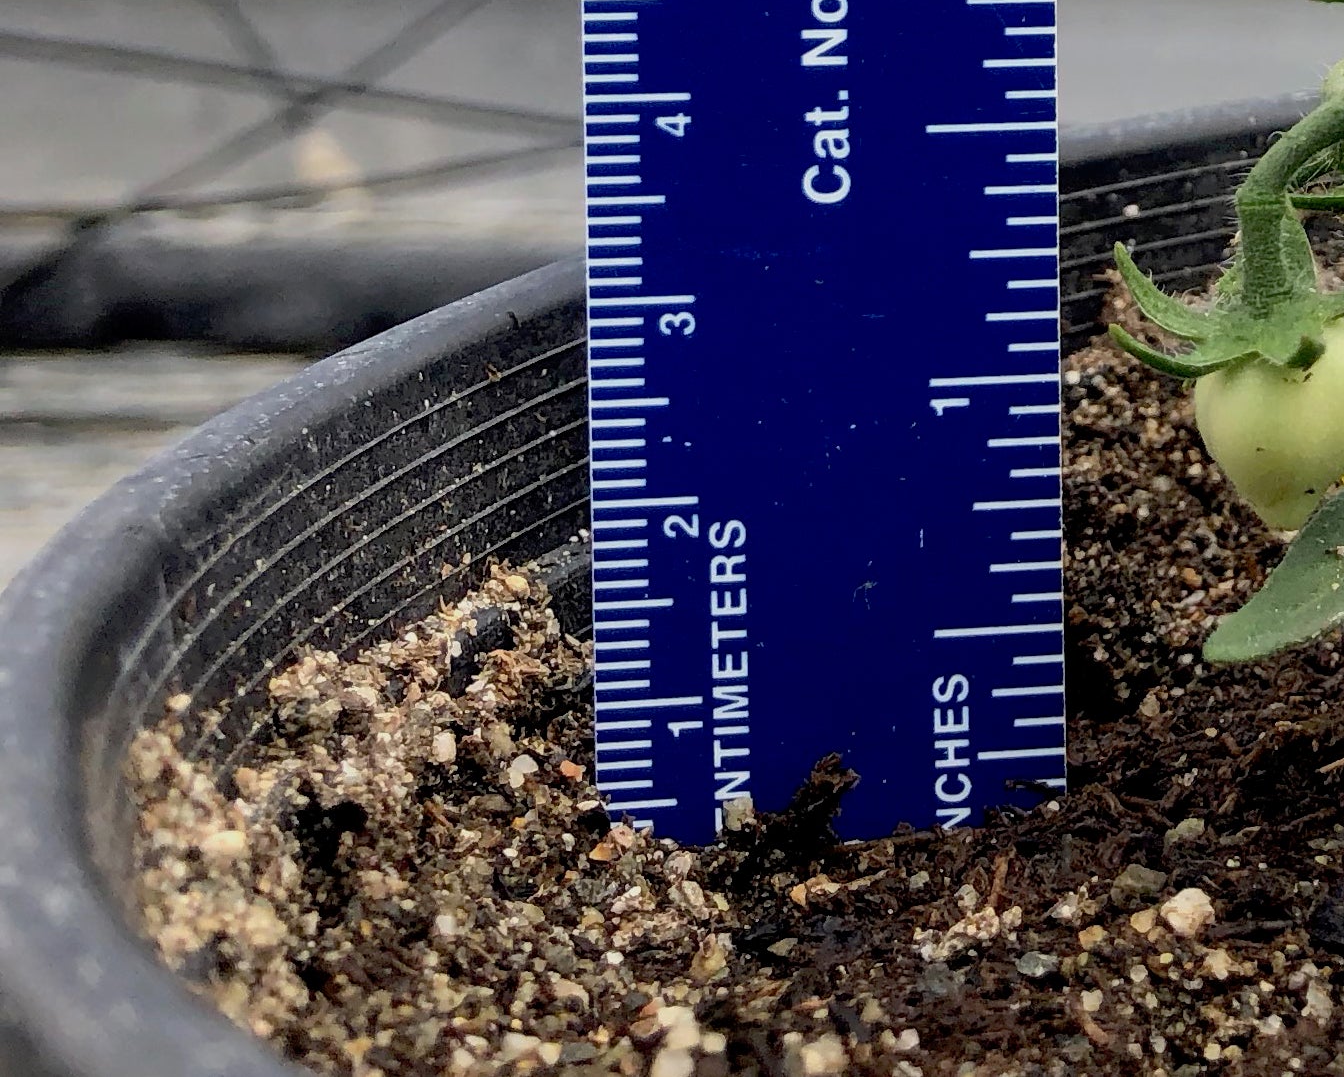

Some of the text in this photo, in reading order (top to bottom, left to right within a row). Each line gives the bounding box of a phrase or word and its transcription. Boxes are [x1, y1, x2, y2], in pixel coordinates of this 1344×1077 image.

[655, 112, 692, 137] 4
[802, 89, 852, 204] Cat.
[658, 311, 696, 336] 3
[929, 397, 970, 416] 1
[663, 514, 700, 538] 2
[708, 519, 751, 833] NTIMETERS
[667, 720, 704, 737] 1
[931, 673, 972, 830] NCHES
